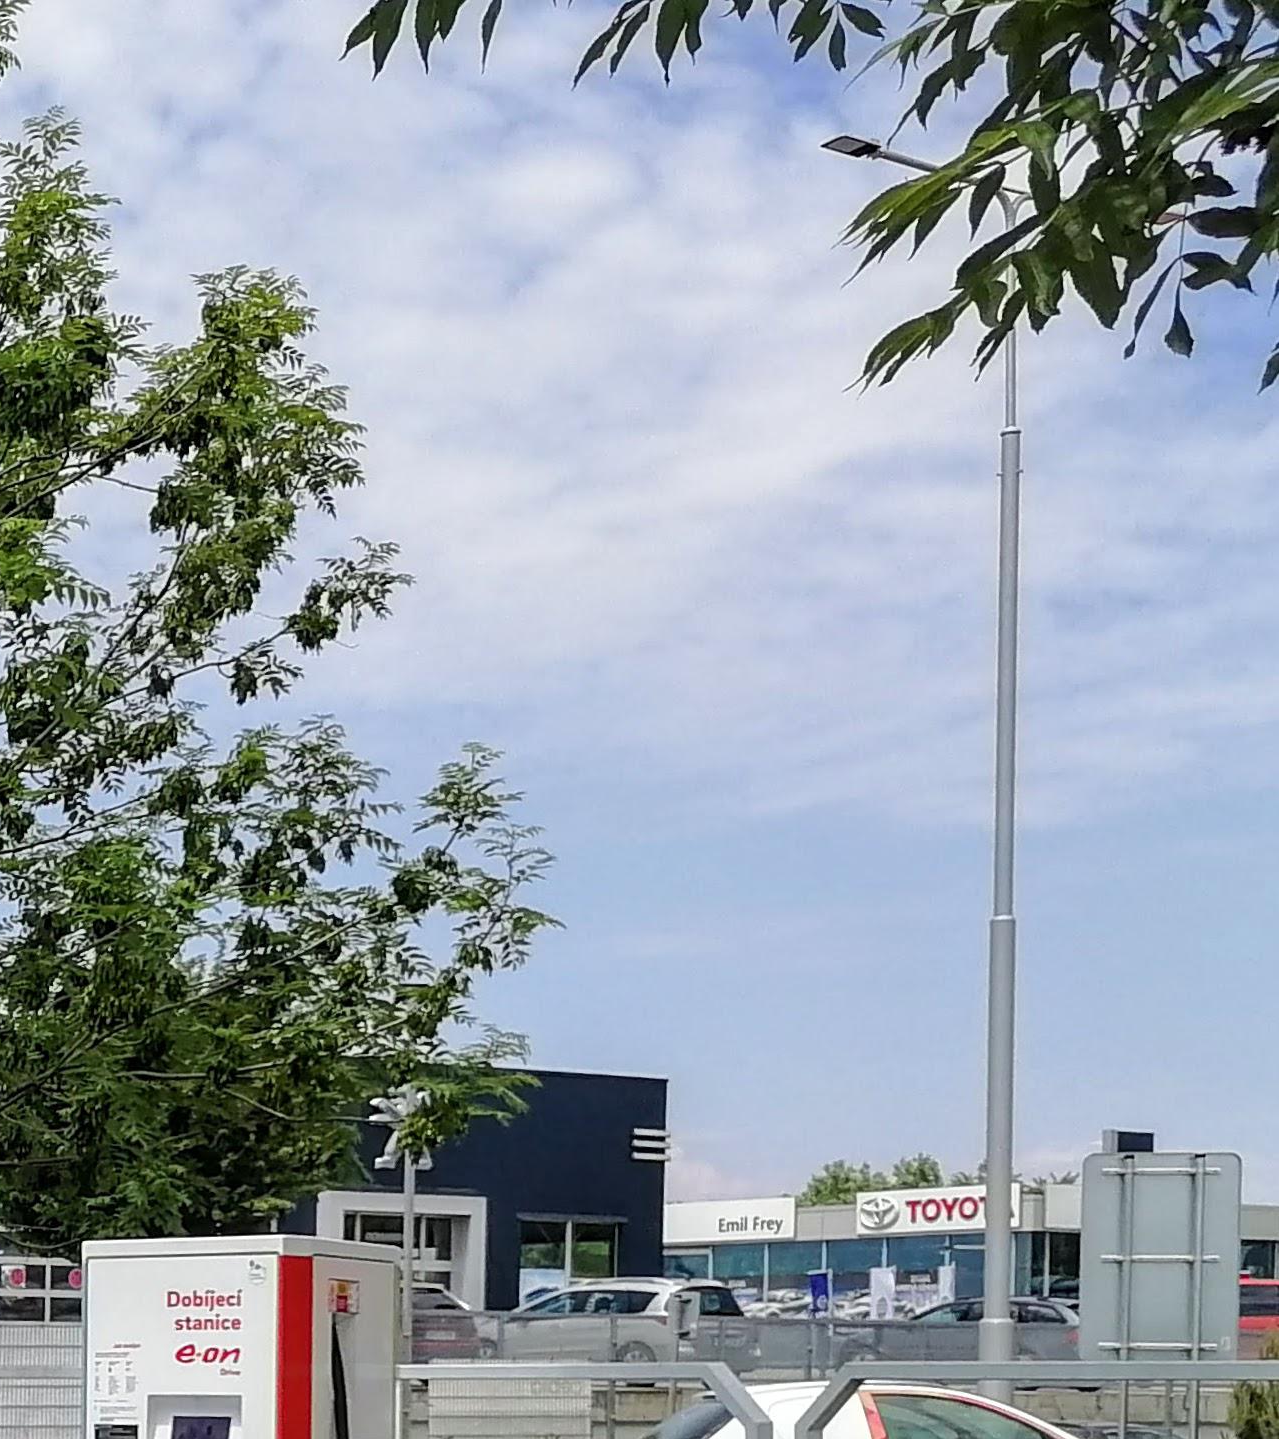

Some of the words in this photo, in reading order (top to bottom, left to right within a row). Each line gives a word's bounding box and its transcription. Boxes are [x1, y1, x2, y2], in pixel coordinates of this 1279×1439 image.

[718, 1216, 748, 1233] Emil
[753, 1216, 783, 1234] Frey
[167, 1289, 242, 1311] Dobíjecí
[174, 1313, 241, 1330] stanice
